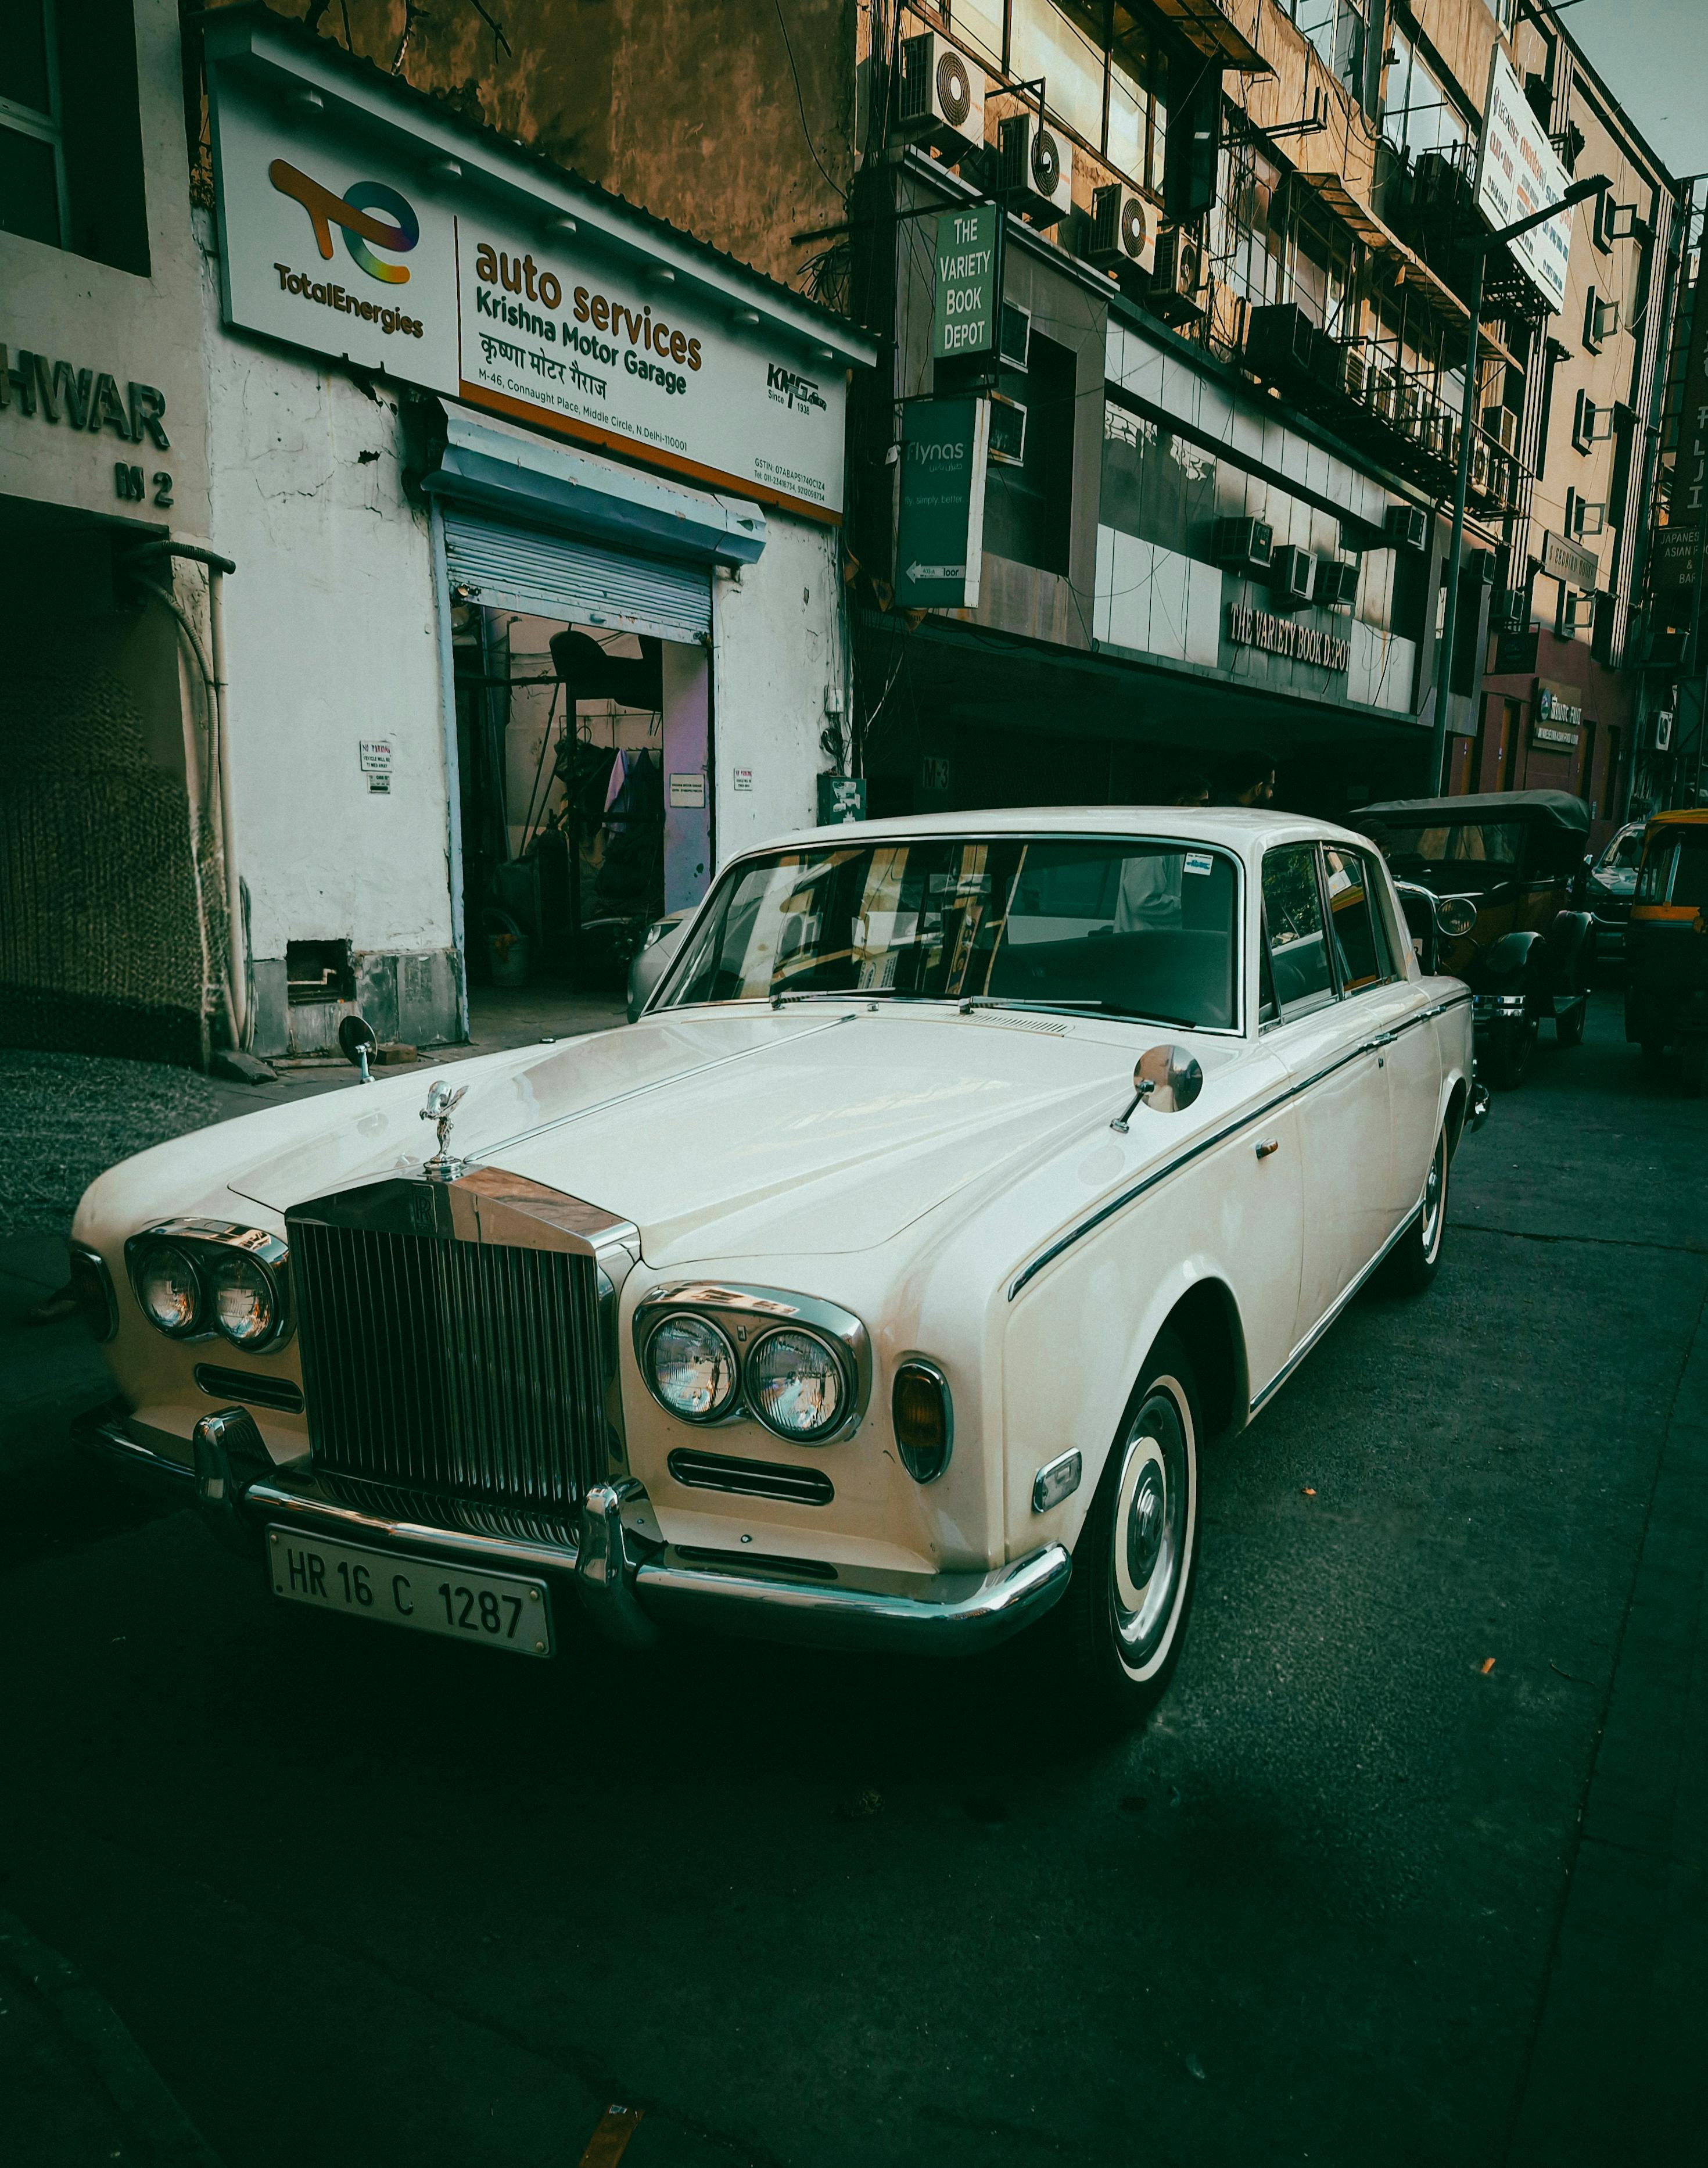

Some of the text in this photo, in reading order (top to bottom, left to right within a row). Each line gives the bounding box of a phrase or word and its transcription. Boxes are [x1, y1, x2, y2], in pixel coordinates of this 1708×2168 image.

[954, 218, 978, 244] THE
[940, 250, 991, 282] VARIETY
[274, 263, 424, 338] TotalEnergies
[476, 243, 702, 371] auto services
[946, 286, 982, 316] BOOK
[476, 286, 687, 395] Krishna Motor Garage
[944, 320, 985, 349] DEPOT
[479, 332, 608, 400] कृष्णा मोटर गैराज
[0, 342, 170, 450] HWAR
[479, 368, 505, 389] M-46,
[508, 378, 554, 405] Connaught
[557, 396, 582, 416] Place,
[583, 405, 609, 425] Middle
[611, 416, 634, 434] Circle,
[768, 389, 810, 415] Since 1938
[907, 442, 964, 465] flynas
[114, 461, 174, 509] M 2
[1660, 531, 1700, 544] JAPANES
[1664, 546, 1691, 558] ASIAN
[1687, 559, 1692, 569] &
[1231, 603, 1253, 645] THE
[1255, 610, 1296, 657] VARIETY
[1297, 625, 1322, 665] BOOK
[287, 1548, 523, 1639] HR 16 C 1287
